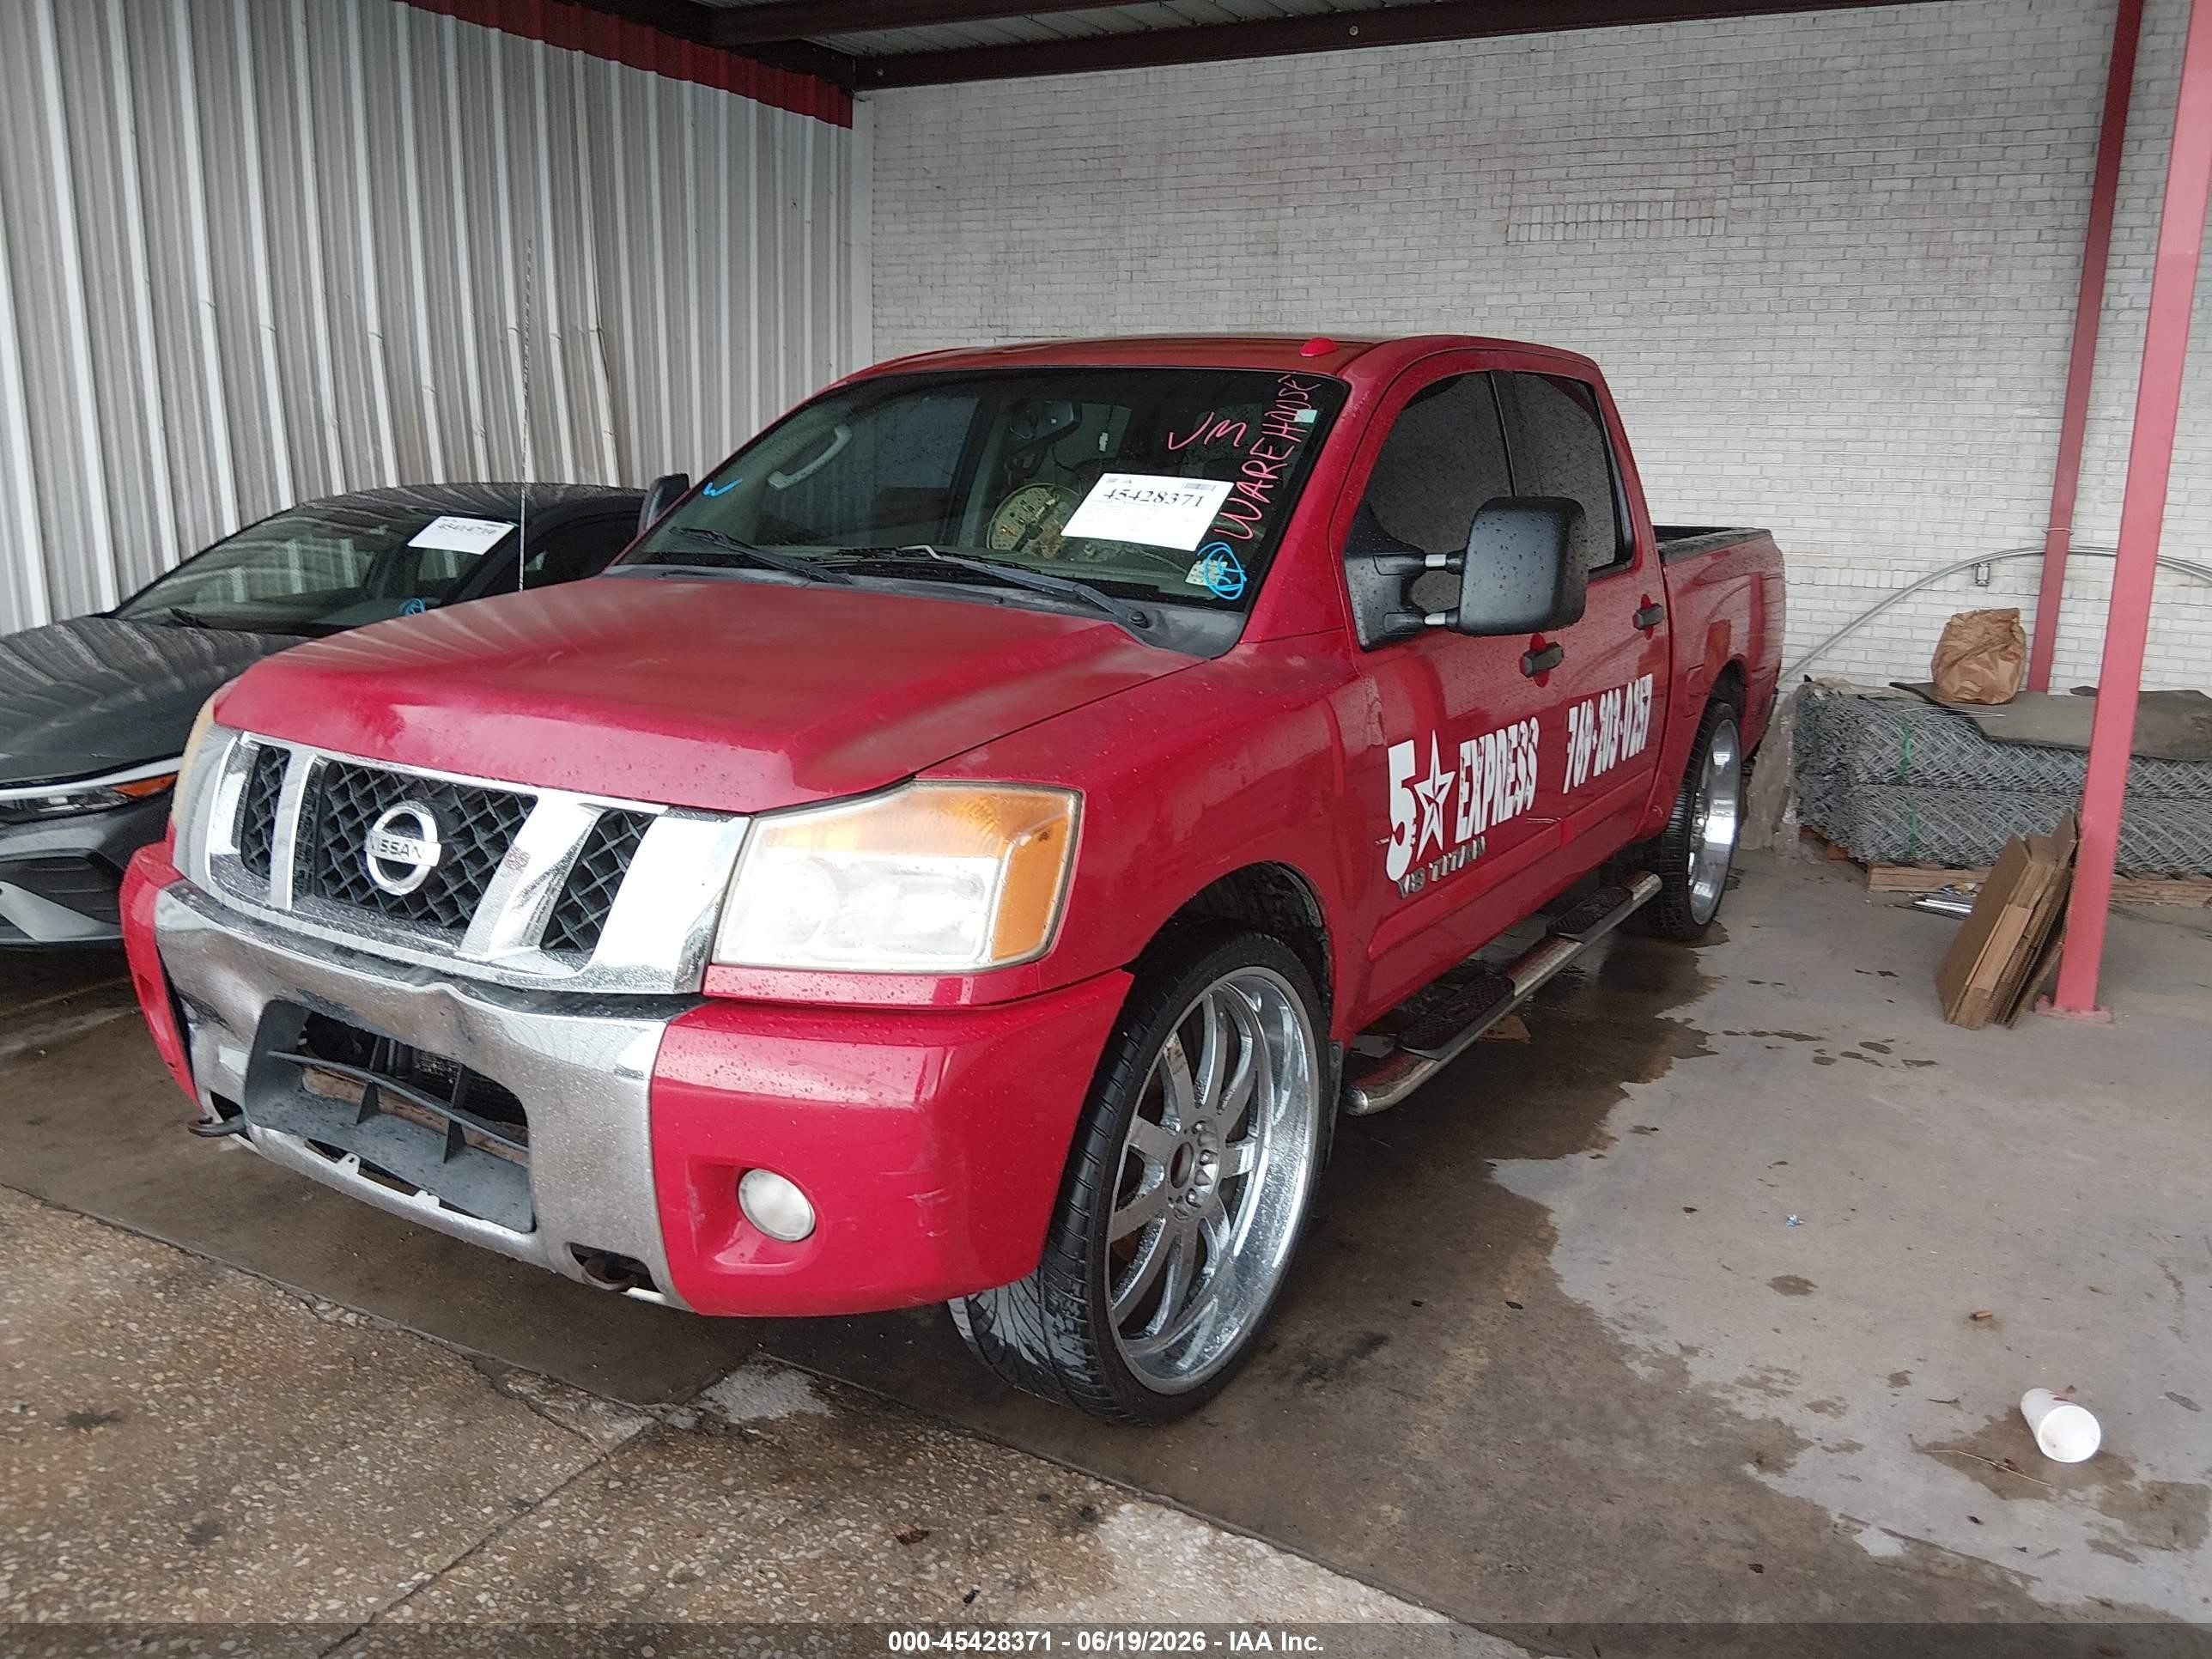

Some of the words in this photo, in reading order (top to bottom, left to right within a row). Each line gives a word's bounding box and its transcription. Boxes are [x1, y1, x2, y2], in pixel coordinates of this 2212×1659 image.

[1103, 488, 1205, 508] 45428371
[1455, 716, 1540, 843] EXPRESS
[1397, 867, 1425, 899] V8
[1429, 836, 1486, 883] TITAN
